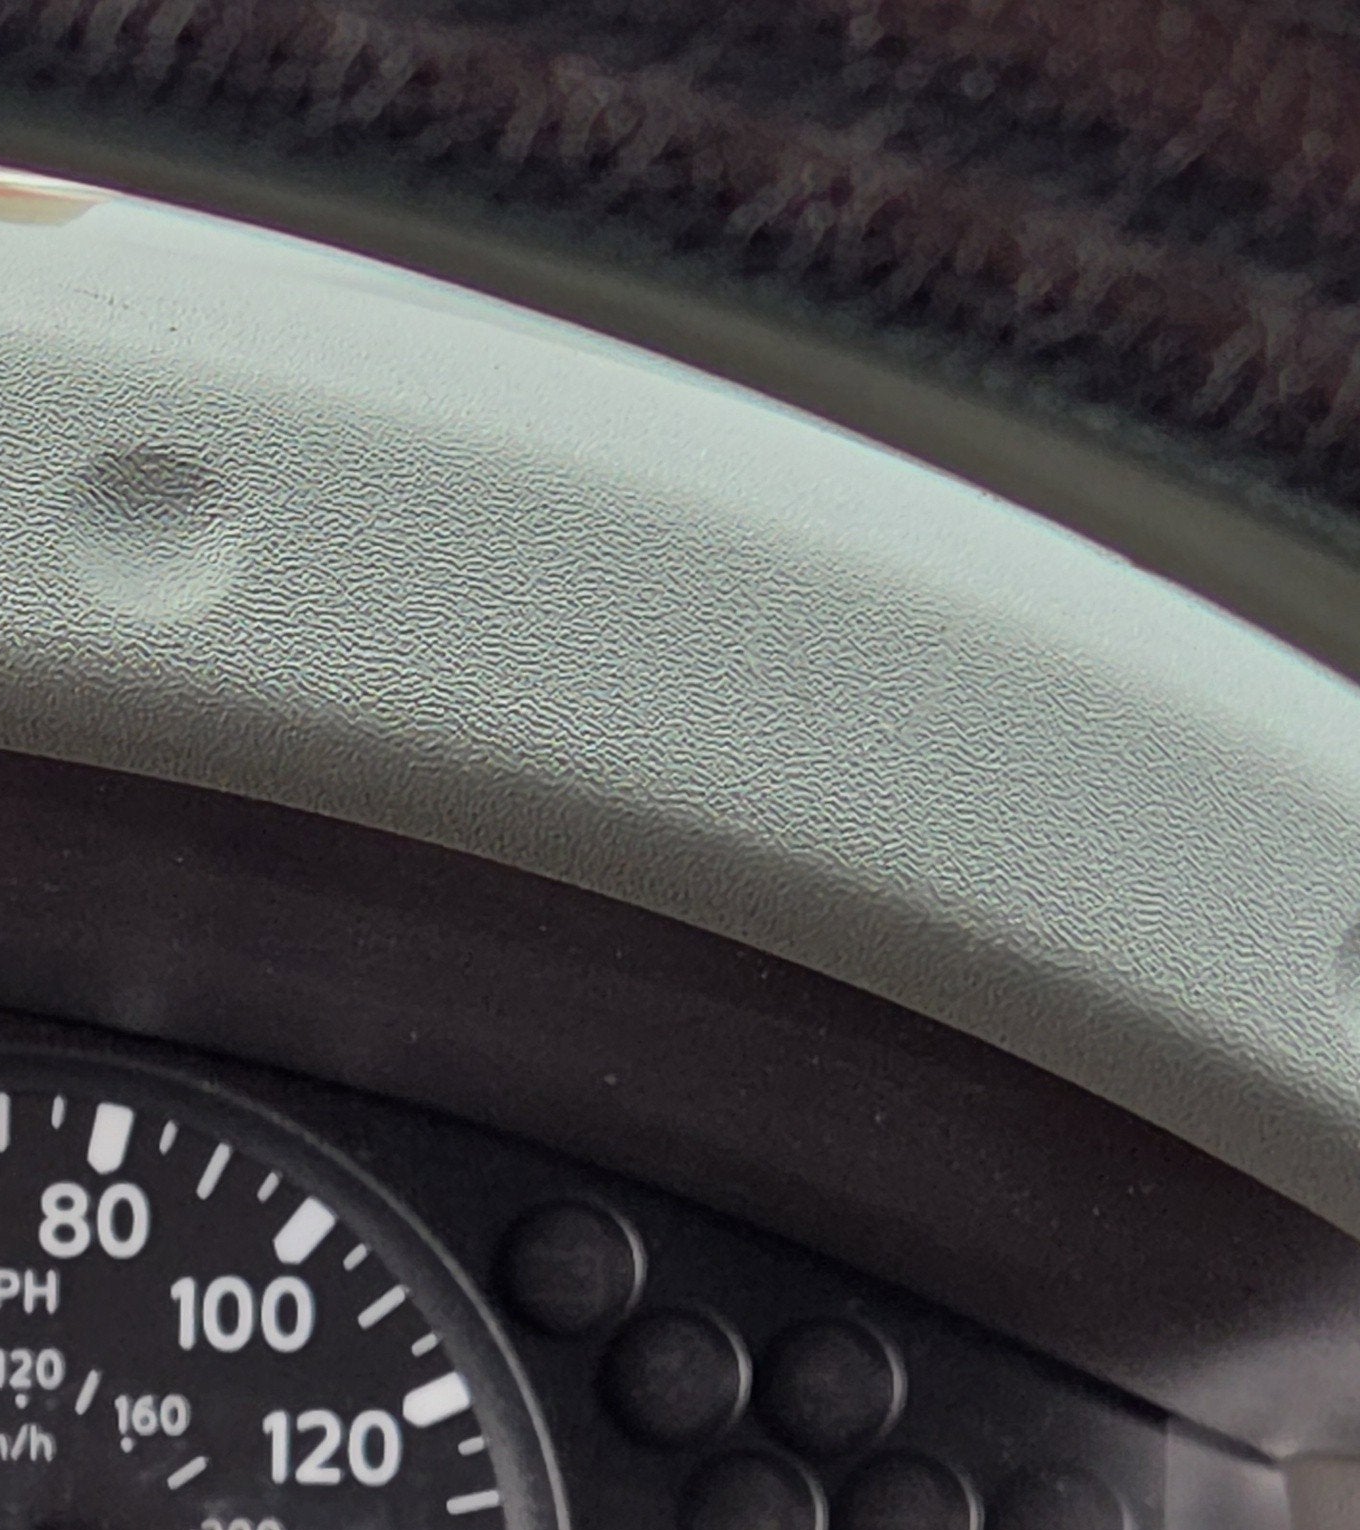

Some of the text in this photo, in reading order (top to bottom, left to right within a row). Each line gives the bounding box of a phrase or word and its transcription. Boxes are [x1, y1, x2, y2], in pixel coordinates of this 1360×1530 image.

[38, 1182, 149, 1258] 80
[170, 1275, 314, 1352] 100
[114, 1394, 190, 1436] 160
[262, 1409, 402, 1486] 120
